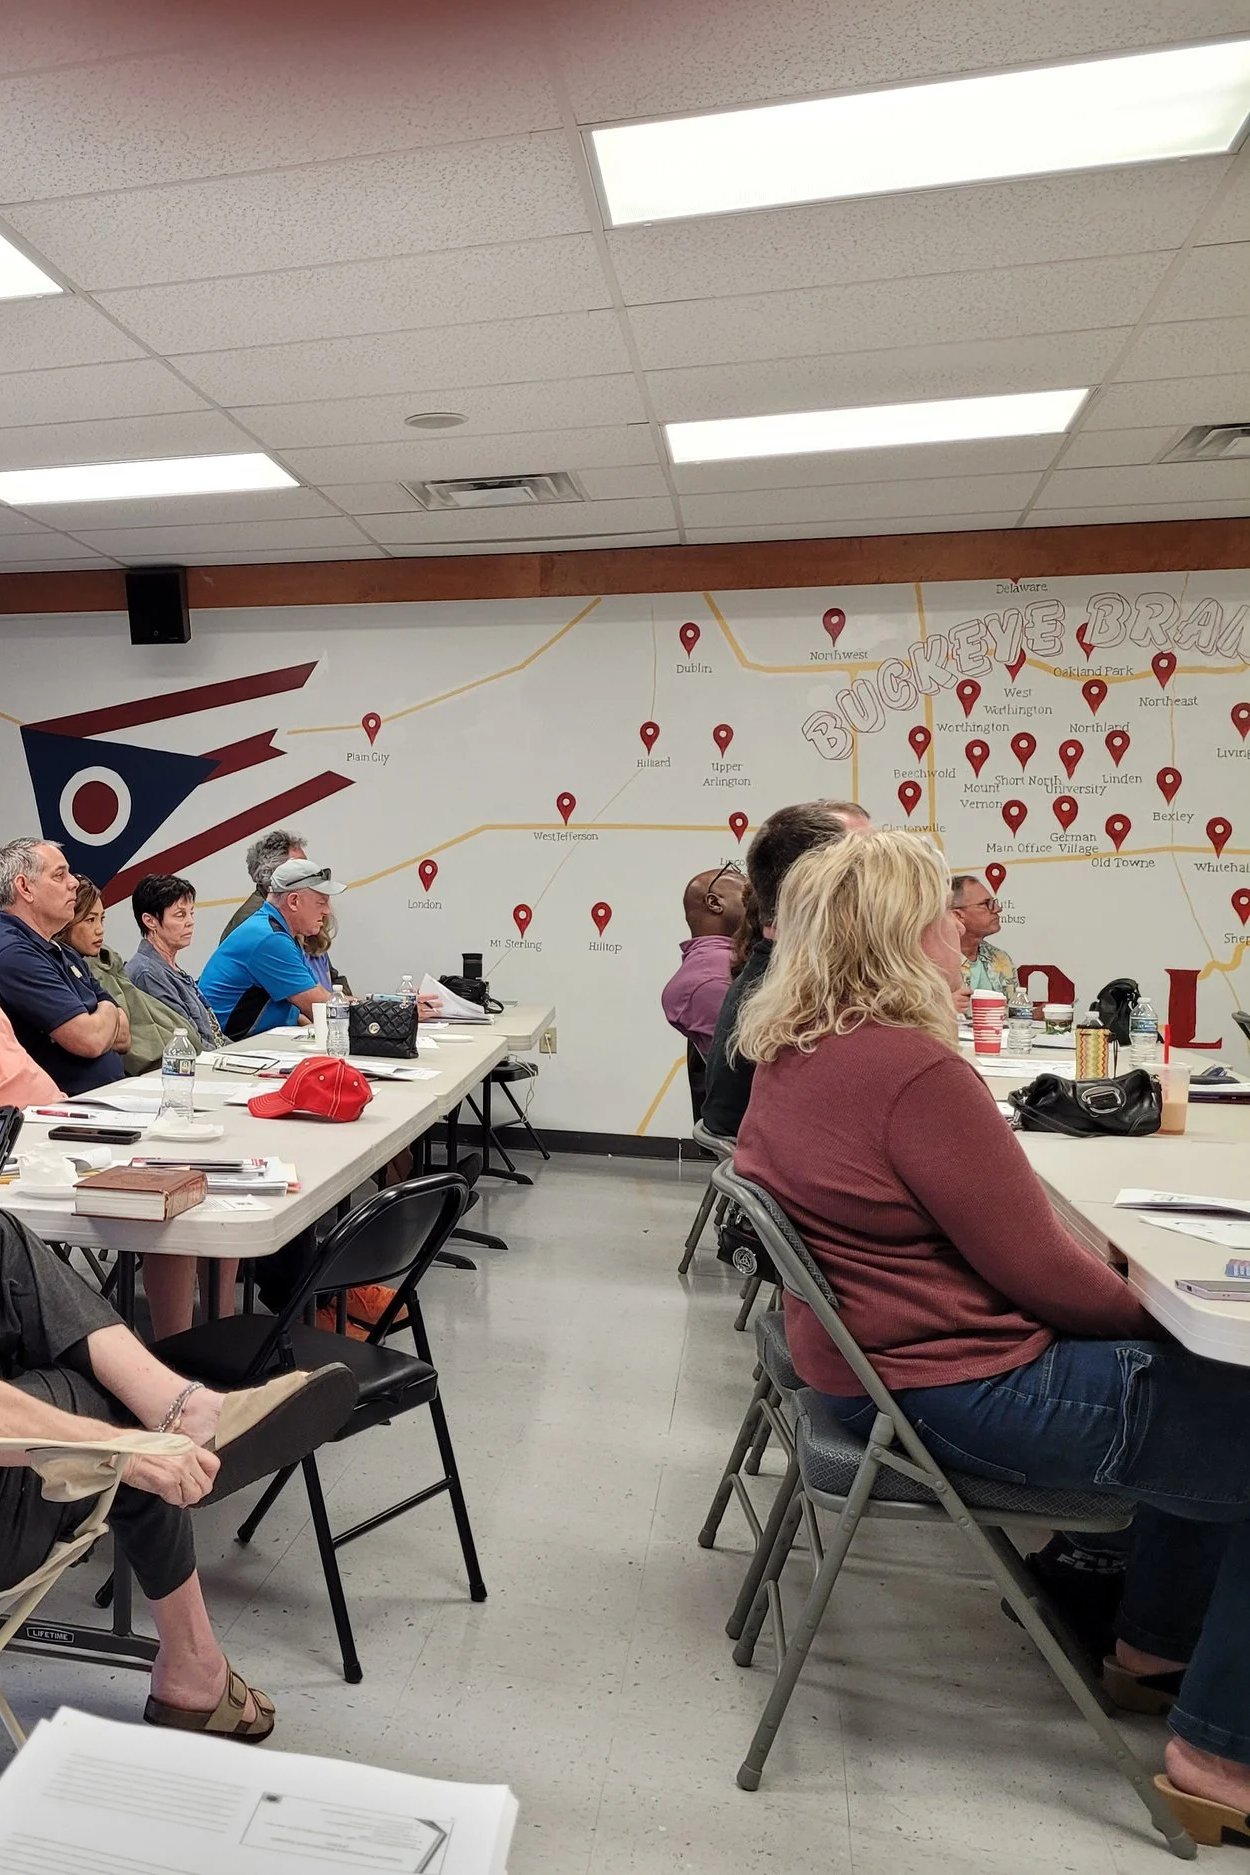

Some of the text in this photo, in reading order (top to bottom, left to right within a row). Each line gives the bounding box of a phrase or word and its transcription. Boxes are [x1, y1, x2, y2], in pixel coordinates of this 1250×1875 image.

[996, 583, 1049, 594] Delaware
[810, 650, 868, 660] Northwest
[676, 663, 713, 674] Dublin
[1053, 666, 1134, 677] Oakland Park
[801, 598, 1066, 760] BUCKEYE
[1004, 688, 1032, 698] West
[1139, 696, 1198, 707] Northeast
[983, 705, 1053, 717] Worthington
[937, 721, 1010, 734] Worthington
[1069, 722, 1130, 733] Northland
[346, 752, 390, 766] Plain City
[637, 756, 671, 768] Hilliard
[711, 762, 743, 773] Upper
[894, 768, 956, 779] Beechwold
[1102, 774, 1143, 784] Linden
[702, 777, 751, 788] Arlington
[995, 775, 1062, 787] Short North
[963, 783, 1000, 793] Mount
[1045, 784, 1108, 795] University
[960, 799, 1003, 809] Vernon
[1153, 812, 1194, 824] Bexley
[533, 832, 599, 841] West Jefferson
[1050, 832, 1097, 842] German
[986, 842, 1052, 853] Main Office
[1058, 844, 1099, 856] Village
[1091, 857, 1155, 868] Old Towne
[408, 899, 442, 909] London
[490, 939, 542, 952] Mt Sterling
[588, 941, 622, 954] Hilltop
[32, 1629, 69, 1641] LIFETIME
